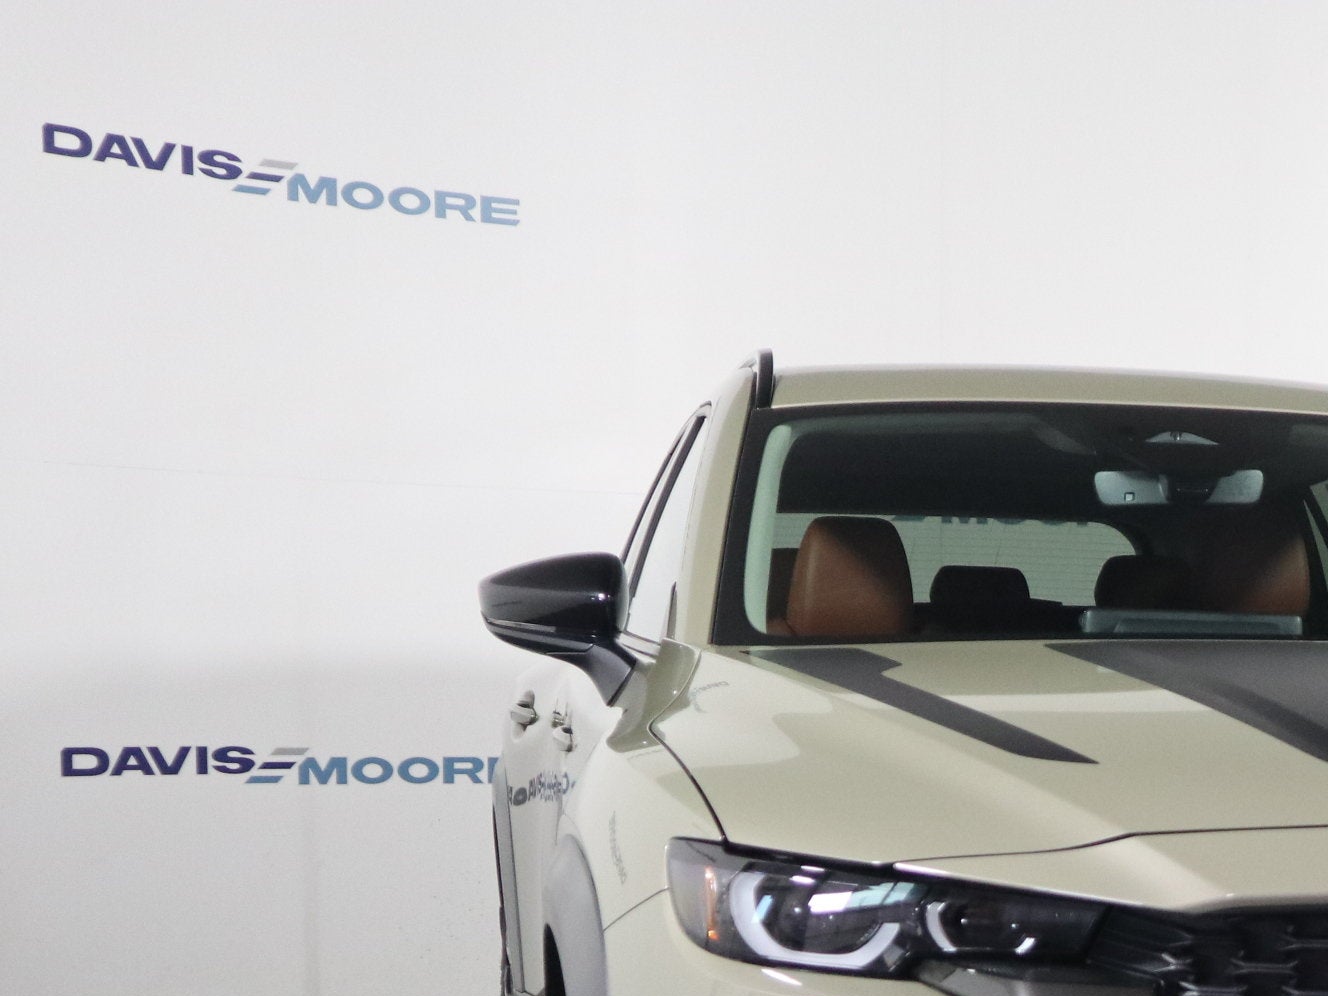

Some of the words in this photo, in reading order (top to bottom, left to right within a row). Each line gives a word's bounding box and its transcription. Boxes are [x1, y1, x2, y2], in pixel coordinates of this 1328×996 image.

[42, 122, 243, 181] DAVIS
[286, 172, 520, 226] MOORE
[60, 745, 256, 777] DAVIS
[301, 756, 500, 785] MOOR
